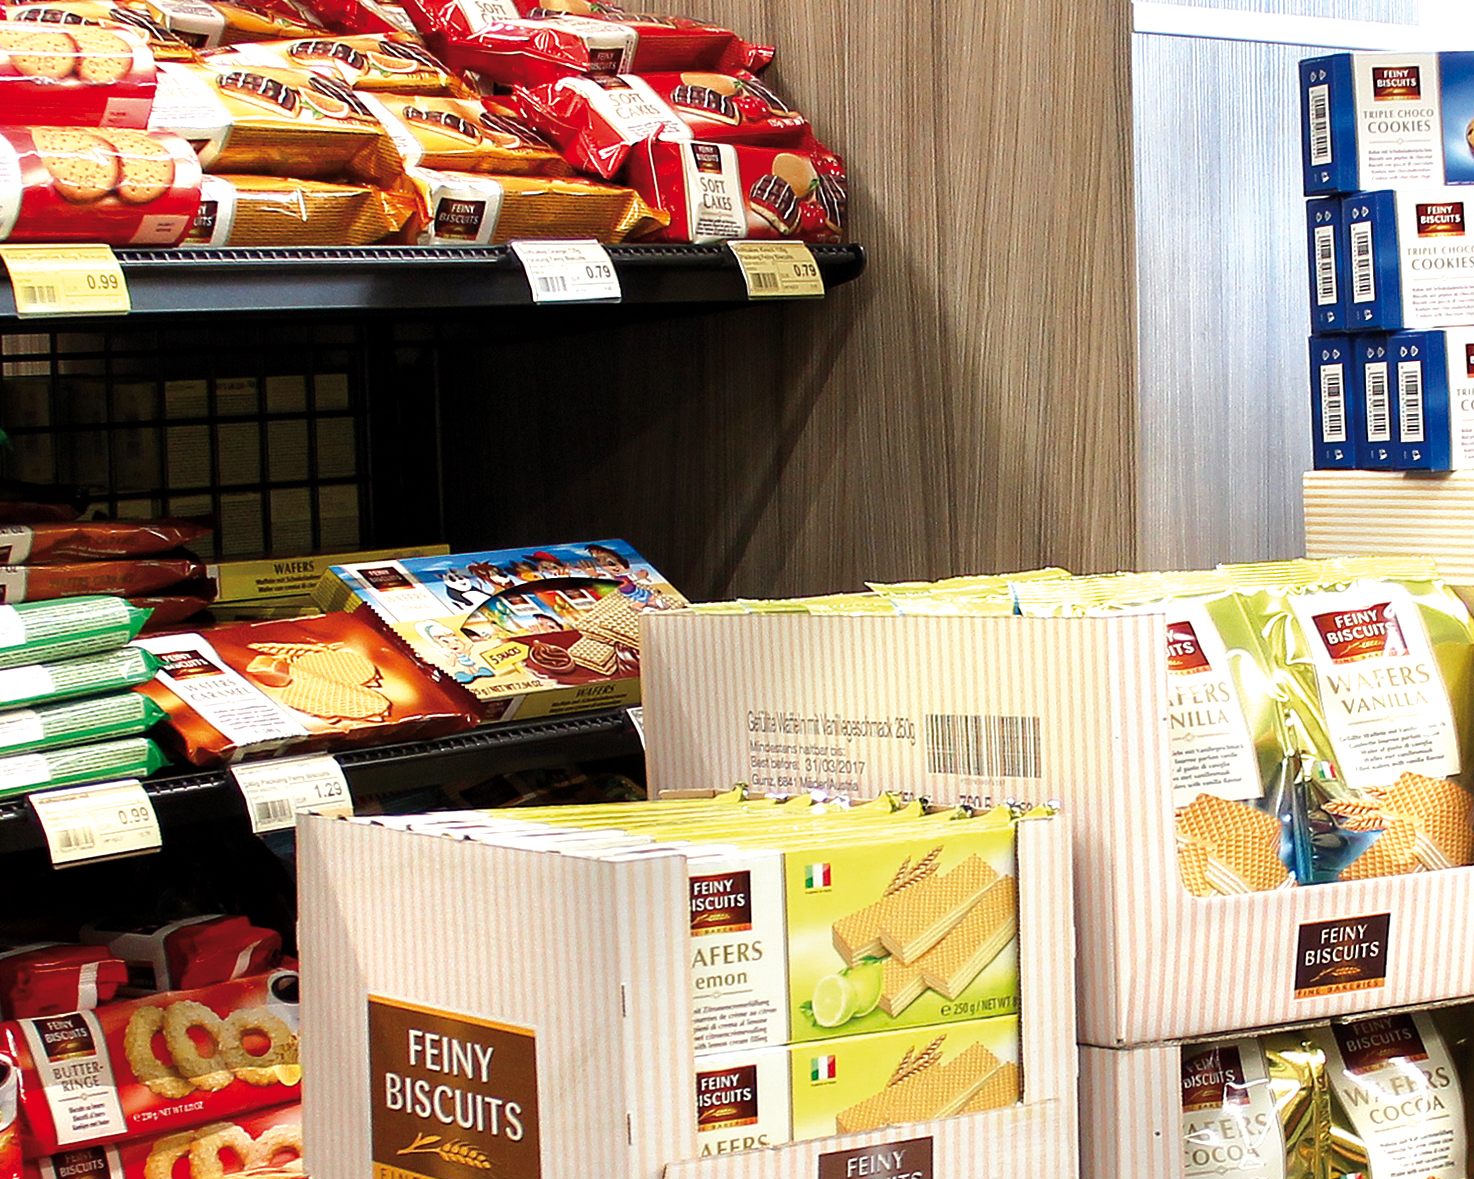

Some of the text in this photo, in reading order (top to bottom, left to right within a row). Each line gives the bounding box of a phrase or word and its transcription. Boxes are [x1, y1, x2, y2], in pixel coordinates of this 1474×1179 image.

[609, 92, 643, 108] SOFT
[614, 103, 660, 119] CAKES
[1363, 108, 1434, 119] TRIPLE CHOCO
[1368, 120, 1431, 134] COOKIES
[701, 178, 725, 193] SOFT
[702, 192, 731, 210] CAKES
[1406, 247, 1438, 257] TRIPLE
[586, 265, 610, 279] 0.79
[794, 264, 816, 277] 0.79
[87, 275, 117, 289] 0.99
[274, 561, 314, 574] WAFERS
[491, 646, 522, 664] 5 SNACKS
[183, 678, 238, 692] WAFERS
[490, 684, 503, 693] NET
[504, 682, 516, 691] WT
[531, 680, 542, 688] OZ
[1327, 663, 1431, 697] WAFERS
[190, 687, 252, 701] CARAMEL
[1341, 691, 1429, 715] VANILLA
[895, 717, 916, 745] 250g
[750, 756, 768, 768] Best
[805, 759, 865, 774] 31/03/2017
[752, 774, 777, 787] Gunz,
[778, 776, 797, 787] 6841
[315, 781, 342, 799] 1.29
[118, 807, 148, 825] 0.99
[691, 894, 745, 912] ISCUITS
[692, 941, 763, 968] AFERS
[1305, 940, 1380, 967] BISCUITS
[695, 970, 748, 990] emon
[953, 1002, 969, 1014] 250
[969, 1003, 975, 1016] g
[981, 998, 996, 1010] NET
[998, 996, 1011, 1009] WT
[408, 1029, 494, 1083] FEINY
[53, 1063, 104, 1080] BUTTER-
[62, 1078, 100, 1092] RINGE
[698, 1087, 752, 1106] ISCUITS
[385, 1072, 524, 1141] BISCUITS
[1369, 1095, 1446, 1125] COCOA
[846, 1150, 906, 1178] FEINY
